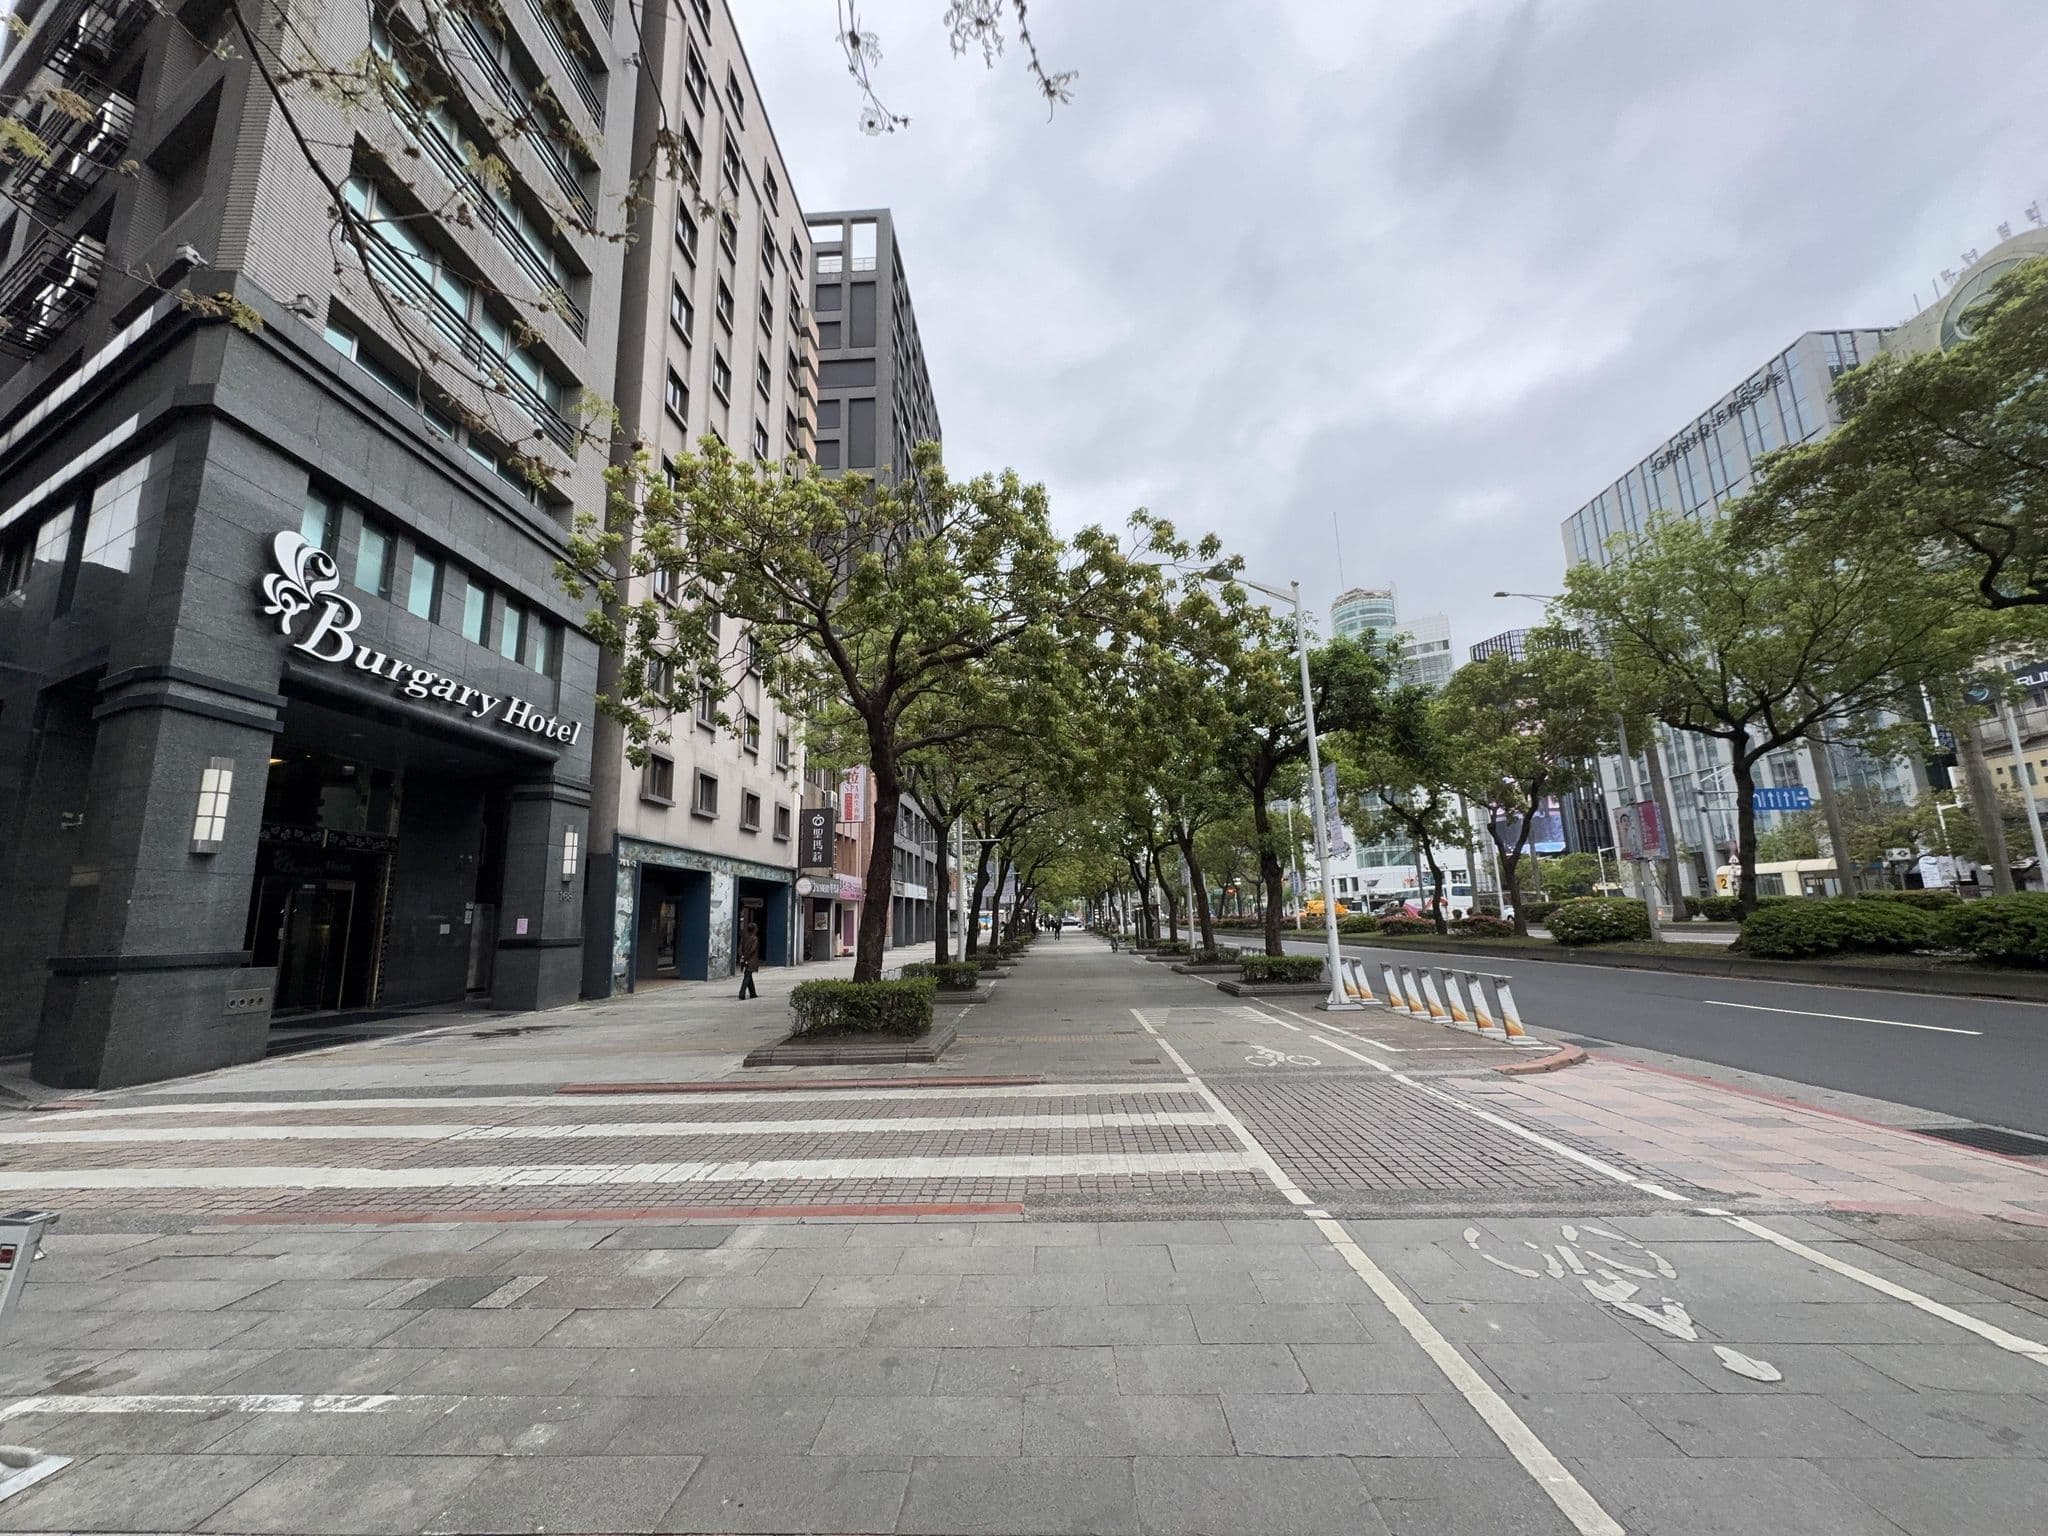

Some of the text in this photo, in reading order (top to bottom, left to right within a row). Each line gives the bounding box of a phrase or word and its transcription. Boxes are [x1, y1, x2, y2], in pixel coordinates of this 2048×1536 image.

[294, 591, 582, 746] Burgary Hotel
[1720, 878, 1728, 890] 2
